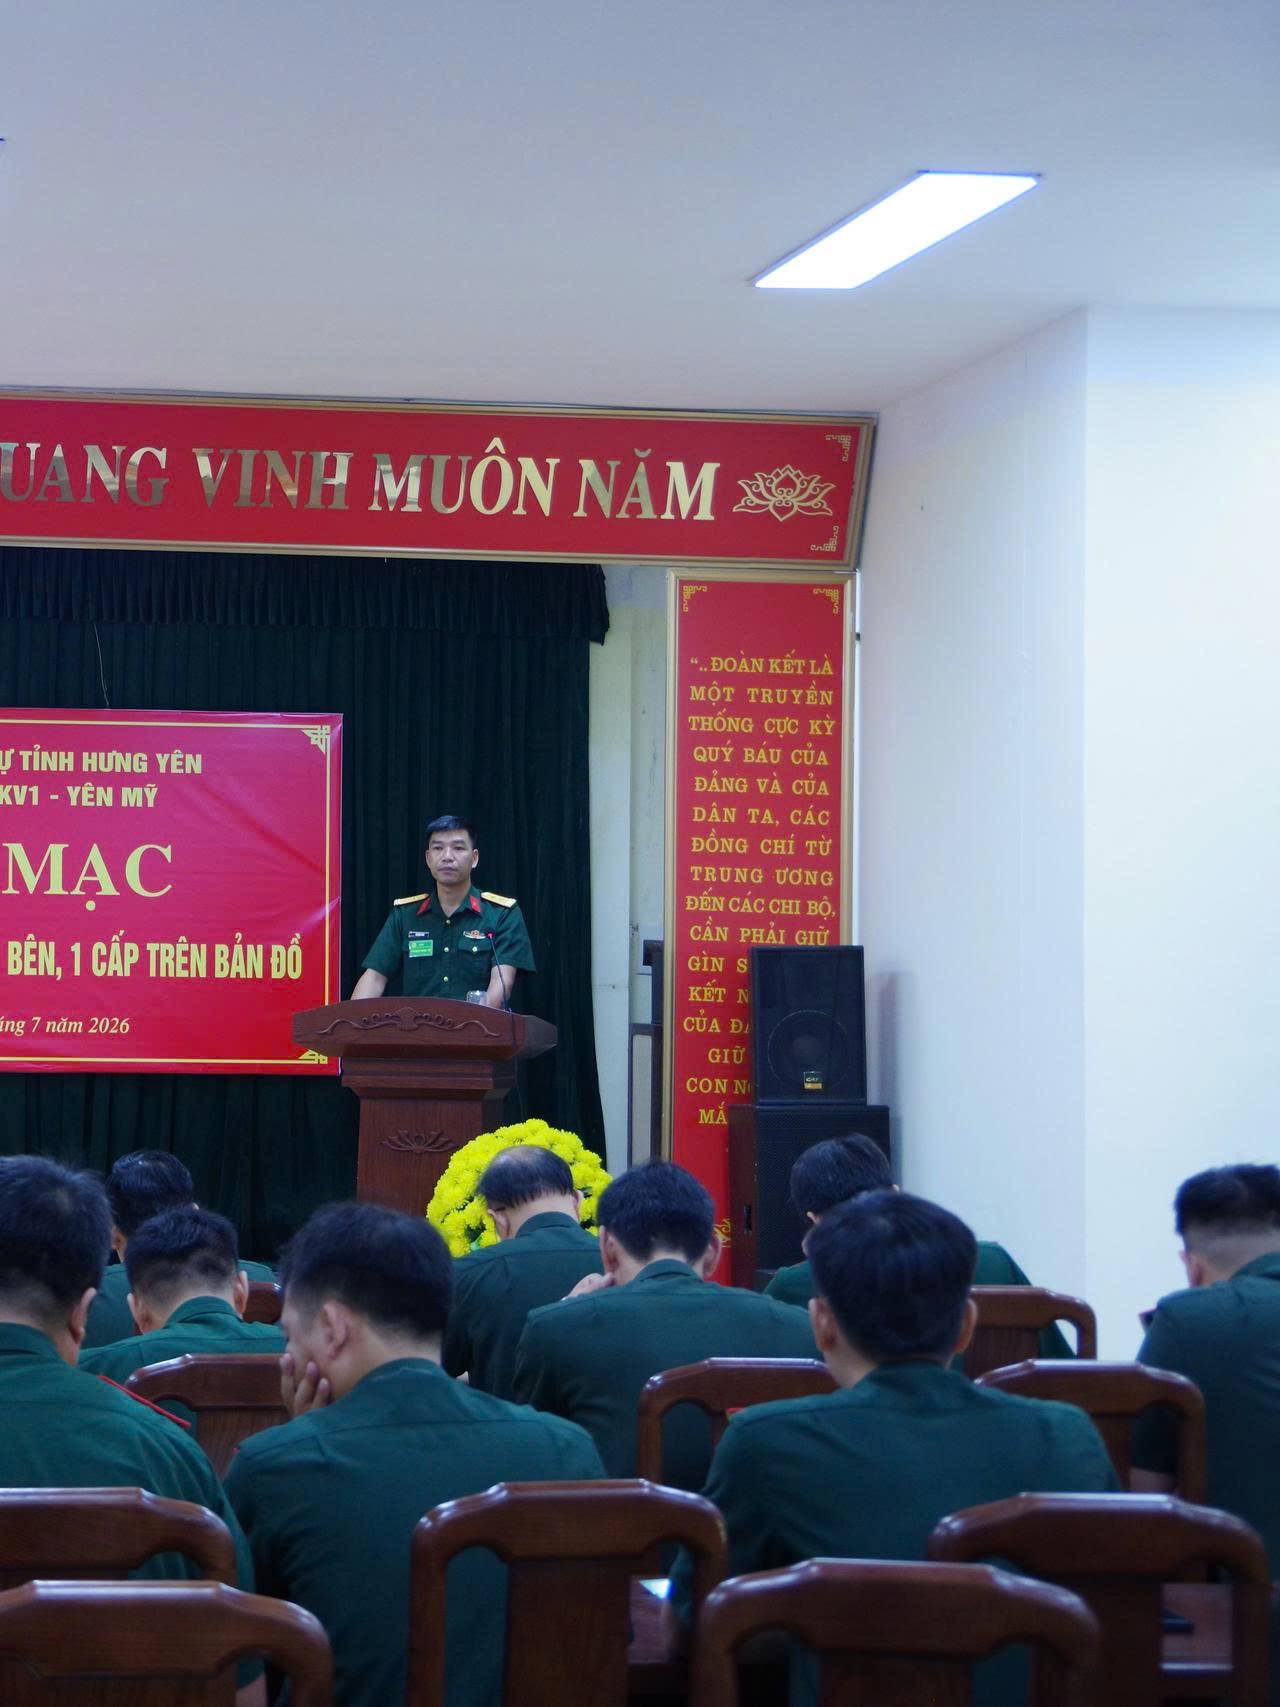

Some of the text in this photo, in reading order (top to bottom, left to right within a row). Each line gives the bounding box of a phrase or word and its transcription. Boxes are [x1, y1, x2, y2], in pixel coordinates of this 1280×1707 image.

[192, 448, 354, 509] VINH
[368, 437, 558, 516] MUÔN
[573, 448, 720, 521] NĂM
[769, 650, 805, 674] KẾT
[810, 654, 833, 675] LÀ
[689, 680, 833, 705] MỘT TRUYỀN
[688, 708, 835, 737] THỐNG CỰC KỲ
[20, 744, 73, 771] TỈNH
[82, 750, 148, 774] HƯNG
[157, 749, 202, 774] YÊN
[694, 740, 828, 765] QUÝ BÁU CỦA
[67, 783, 113, 806] YÊN
[121, 784, 157, 807] MỸ
[695, 770, 829, 795] ĐẢNG VÀ CỦA
[693, 802, 830, 826] DÂN TA, CÁC
[691, 829, 832, 856] ĐỒNG CHÍ TỪ
[2, 843, 172, 911] MẠC
[691, 867, 833, 885] TRUNG ƯƠNG
[686, 887, 836, 920] ĐẾN CÁC CHI BỘ,
[690, 916, 829, 946] CẦN PHẢI GIỮ
[8, 934, 62, 980] BÊN,
[71, 942, 80, 976] 1
[92, 930, 139, 977] CẤP
[146, 936, 206, 978] TRÊN
[215, 933, 263, 979] BẢN
[271, 933, 302, 979] ĐỒ
[688, 951, 725, 972] GÌN
[688, 980, 726, 1003] KẾT
[31, 1017, 41, 1032] 7
[46, 1018, 82, 1032] năm
[88, 1018, 129, 1034] 2026
[683, 1009, 720, 1032] CỦA
[708, 1045, 746, 1064] GIỮ
[686, 1078, 728, 1094] CON
[699, 1103, 727, 1124] MẮ
